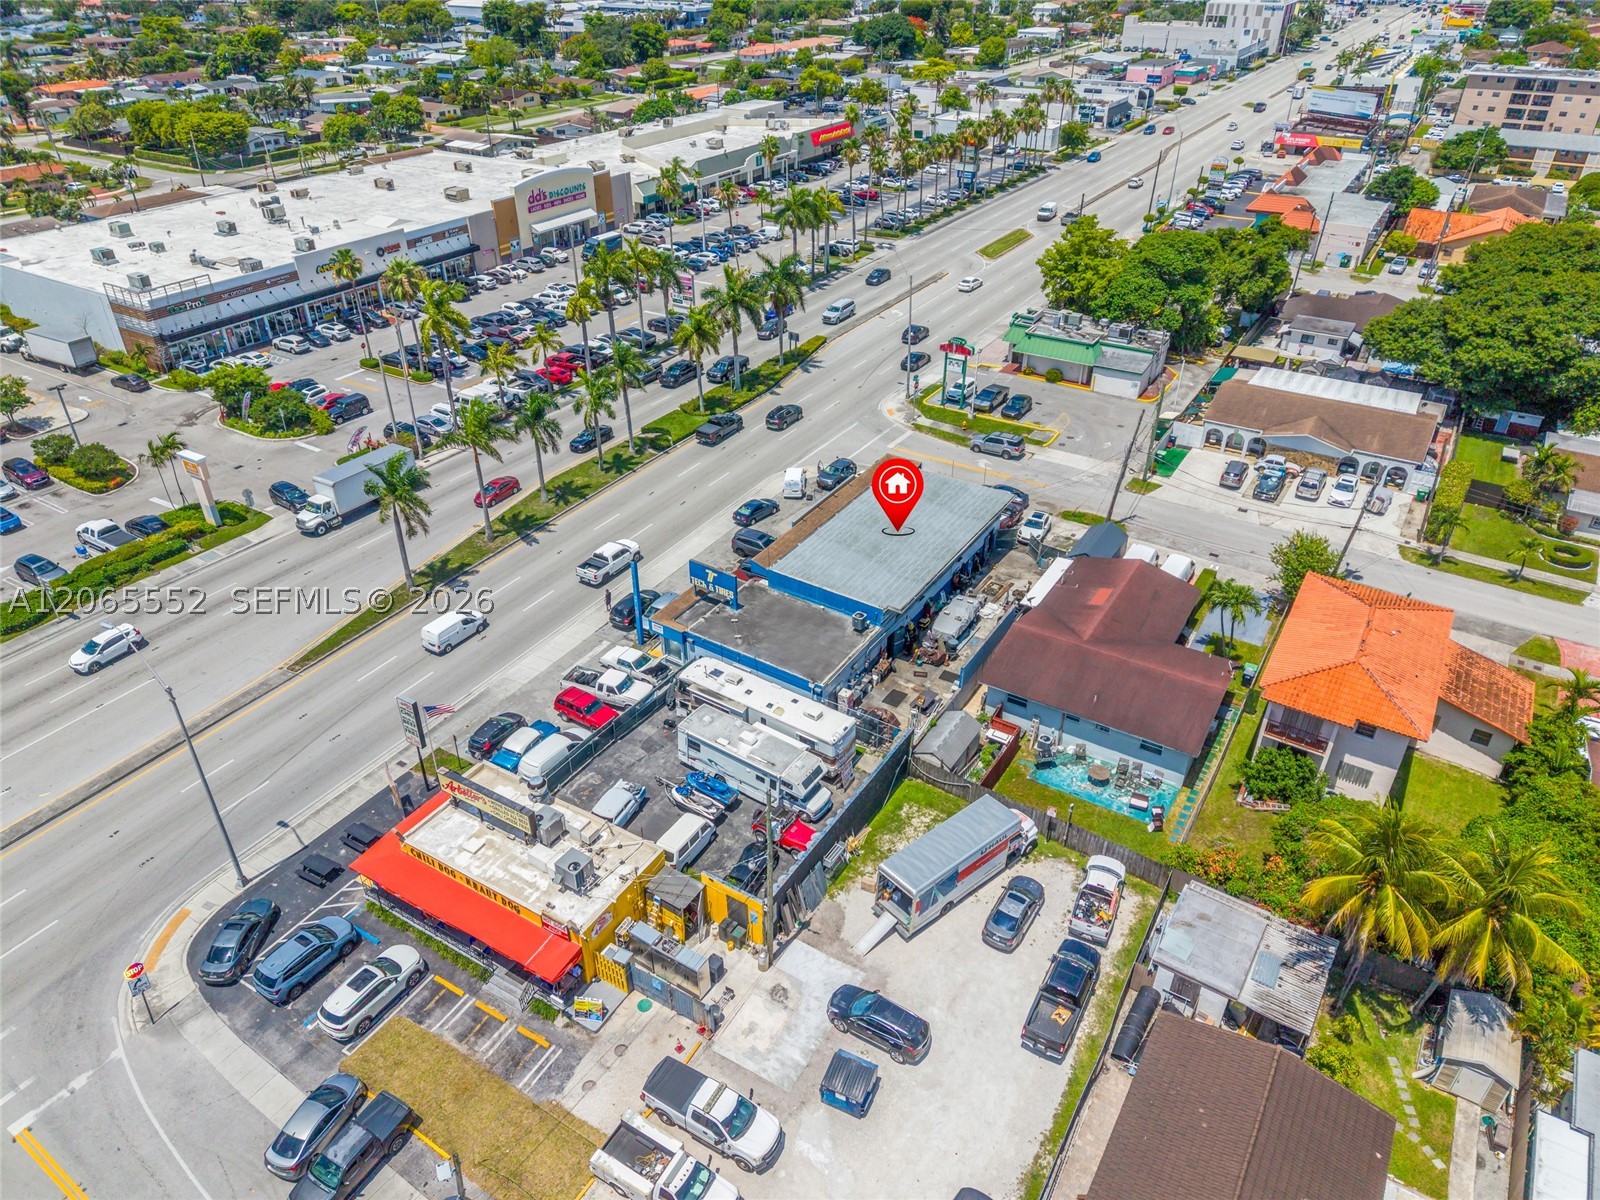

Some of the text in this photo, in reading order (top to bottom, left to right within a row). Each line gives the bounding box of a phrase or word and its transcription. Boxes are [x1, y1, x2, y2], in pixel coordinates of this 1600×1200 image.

[528, 183, 586, 204] dd's DISCOUNTS
[708, 583, 715, 592] &
[714, 585, 735, 600] TIRES
[442, 780, 488, 806] Arbetter's
[410, 848, 521, 915] CHILI DOG KRAUT DOG
[125, 964, 143, 977] STOP
